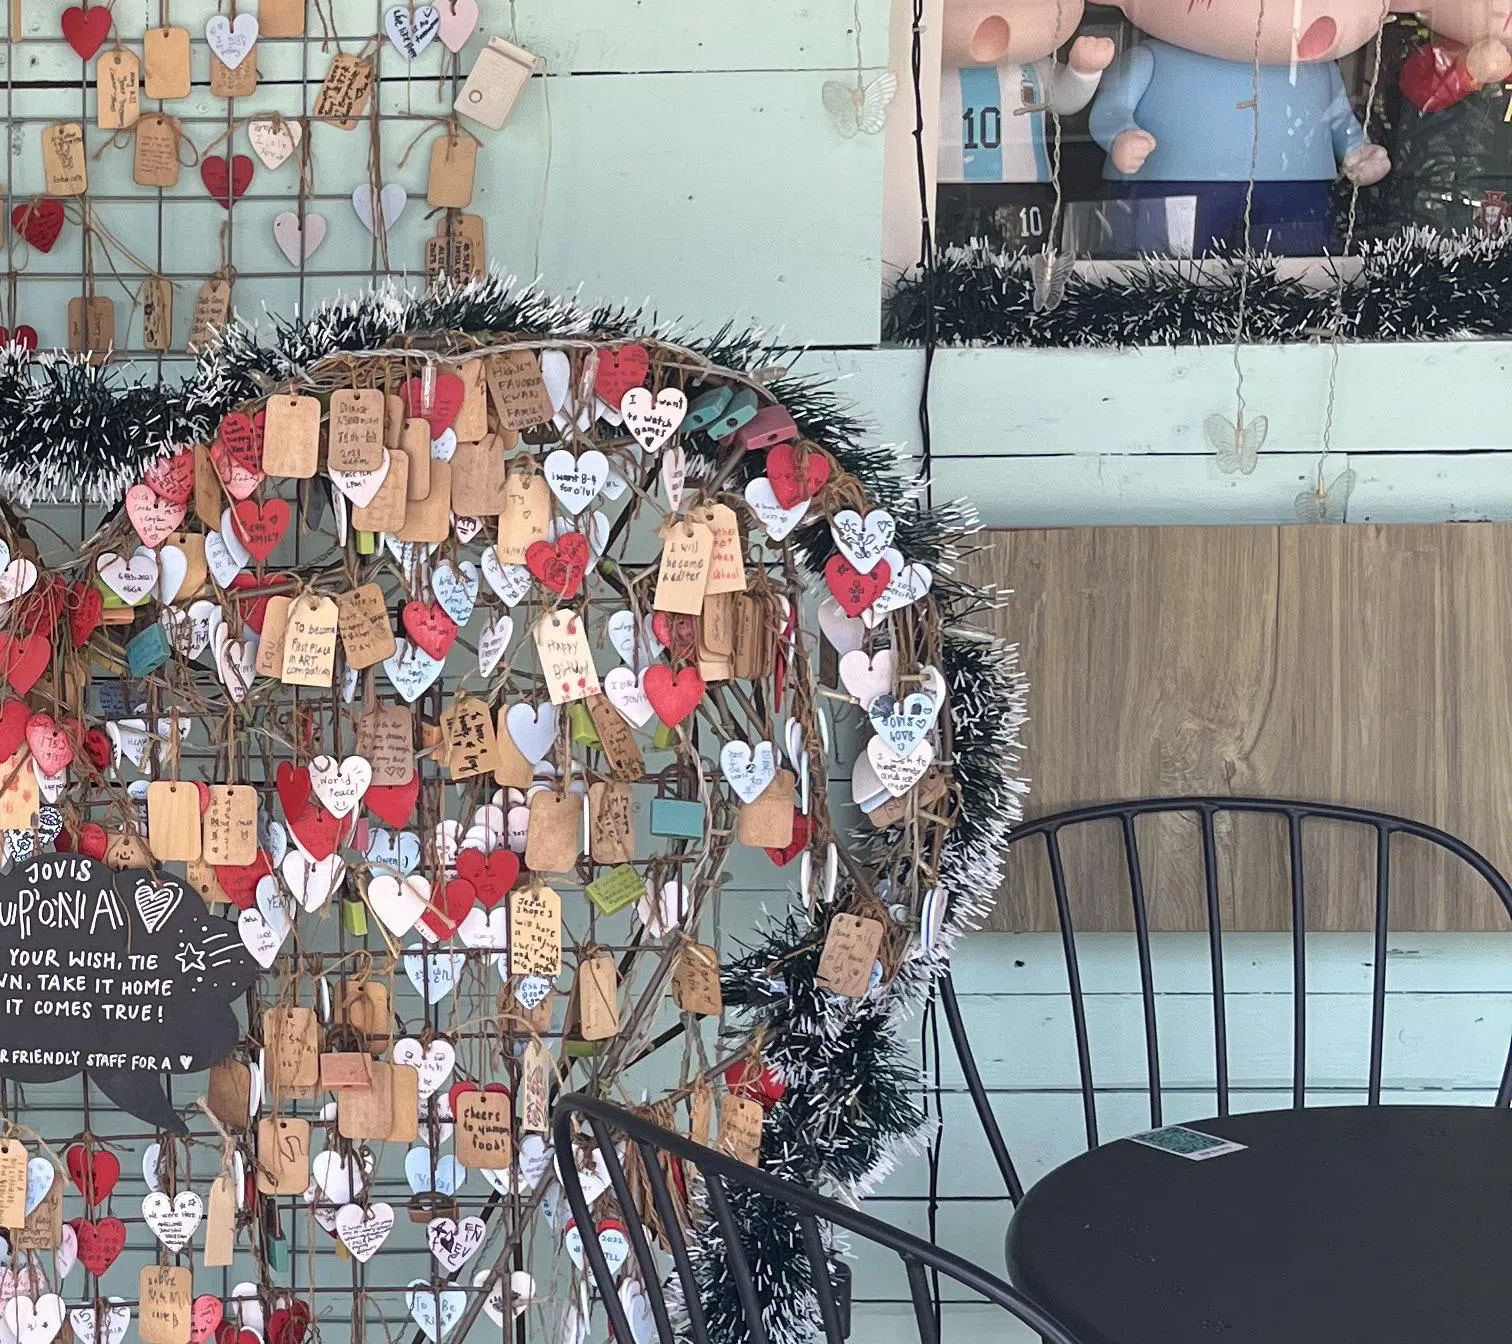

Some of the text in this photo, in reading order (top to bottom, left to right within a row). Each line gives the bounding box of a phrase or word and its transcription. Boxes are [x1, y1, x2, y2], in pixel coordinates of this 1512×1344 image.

[962, 107, 1001, 149] 10
[1019, 206, 1043, 238] 10
[628, 394, 684, 409] I want
[627, 412, 673, 427] to watch
[634, 426, 667, 437] games
[666, 559, 704, 569] become
[320, 774, 351, 785] World
[25, 859, 92, 885] JOVIS
[9, 948, 56, 968] YOUR
[68, 951, 123, 971] WISH,
[127, 954, 159, 971] TIE
[37, 974, 87, 992] TAKE
[95, 978, 115, 994] IT
[121, 980, 173, 996] HOME
[6, 998, 24, 1015] IT
[34, 999, 91, 1019] COMES
[101, 1004, 164, 1024] TRUE!
[11, 1049, 80, 1067] FRIENDLY
[87, 1053, 127, 1068] STAFF
[131, 1055, 159, 1070] FOR
[161, 1056, 171, 1070] A
[464, 1104, 500, 1121] cheers
